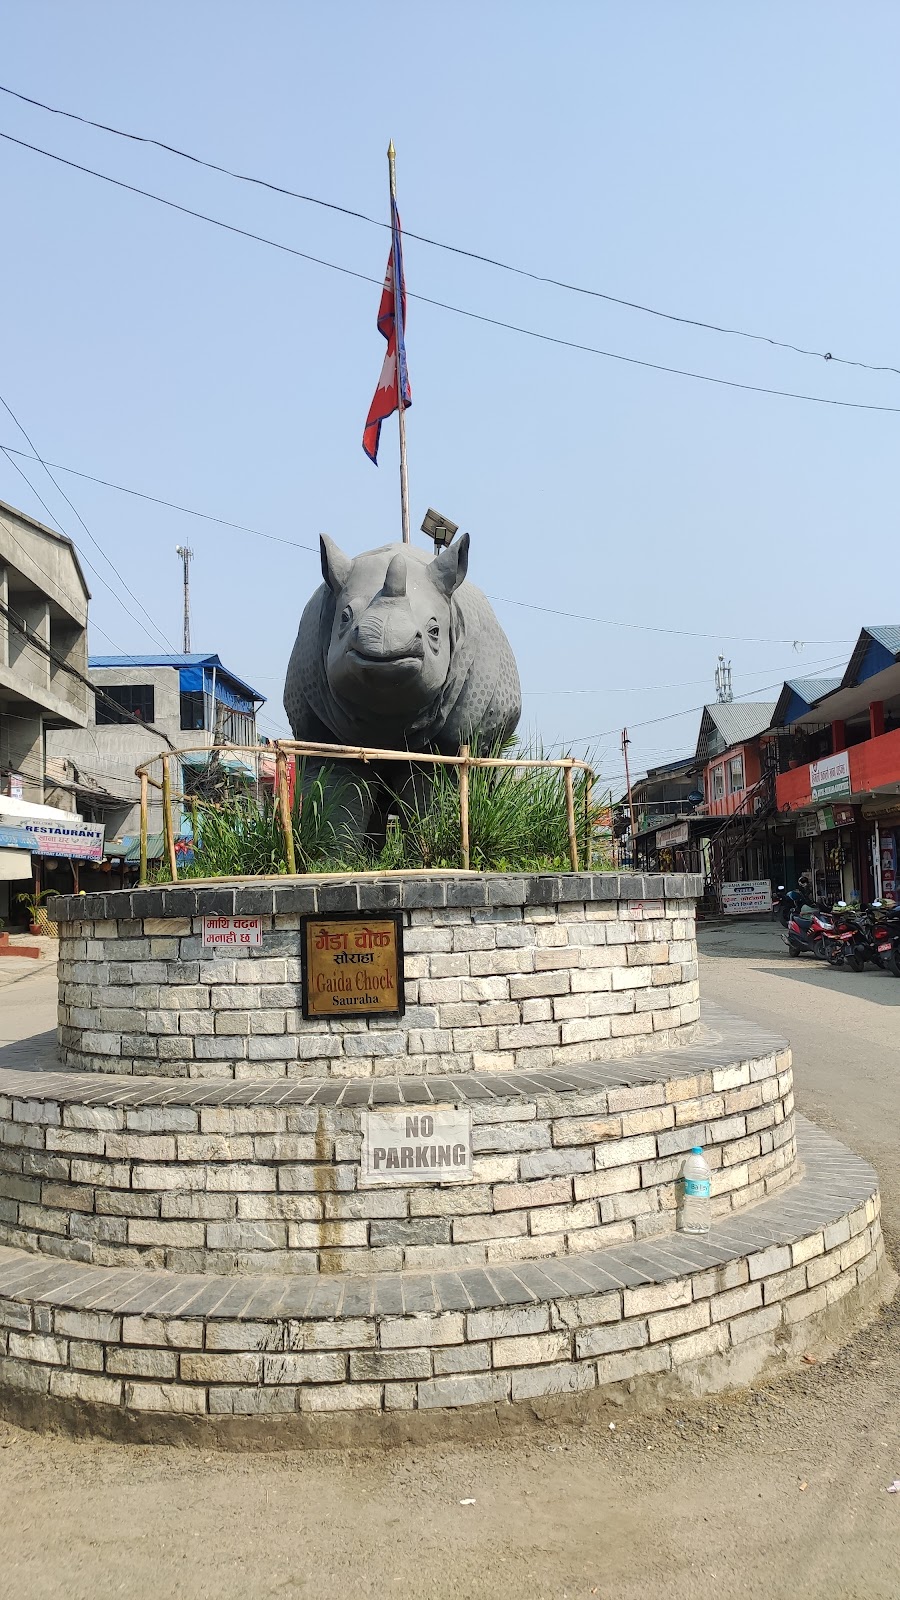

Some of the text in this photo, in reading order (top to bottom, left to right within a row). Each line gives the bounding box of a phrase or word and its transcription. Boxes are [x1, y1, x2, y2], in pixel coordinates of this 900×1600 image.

[25, 825, 102, 839] RESTAURANT
[206, 916, 230, 929] माथि
[206, 930, 238, 944] मनाही
[240, 933, 251, 943] छ
[316, 968, 395, 993] Gaida Chock
[332, 993, 380, 1006] Sauraha
[405, 1115, 434, 1138] NO
[373, 1143, 467, 1170] PARKING
